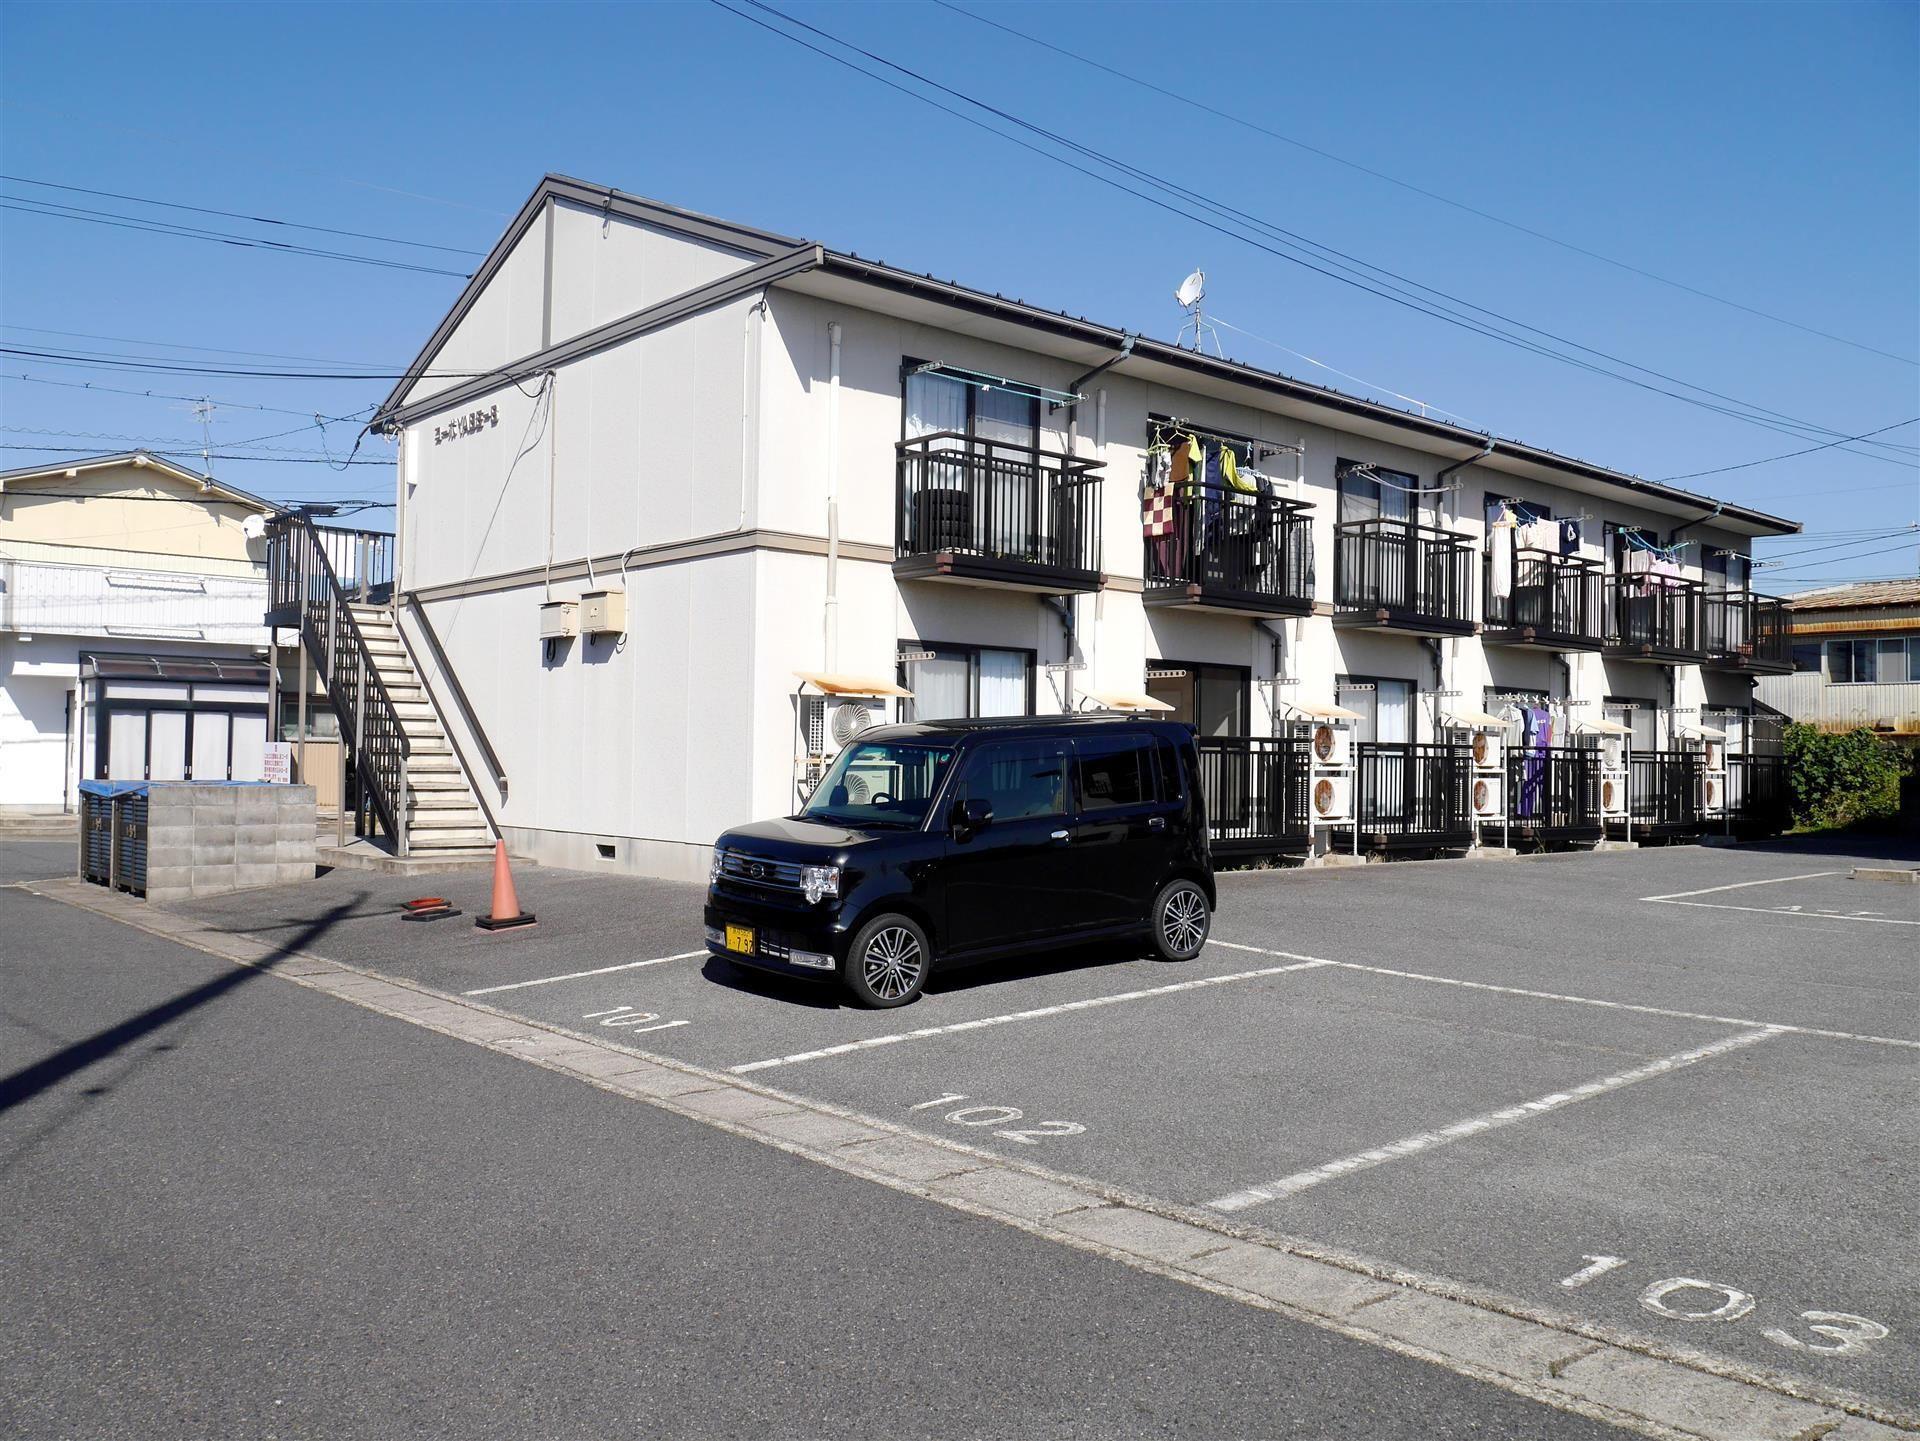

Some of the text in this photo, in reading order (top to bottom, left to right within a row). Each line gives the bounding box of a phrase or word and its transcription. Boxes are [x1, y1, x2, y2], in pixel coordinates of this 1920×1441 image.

[582, 1006, 690, 1033] 101
[910, 1092, 1087, 1145] 102
[1561, 1255, 1889, 1353] 103
